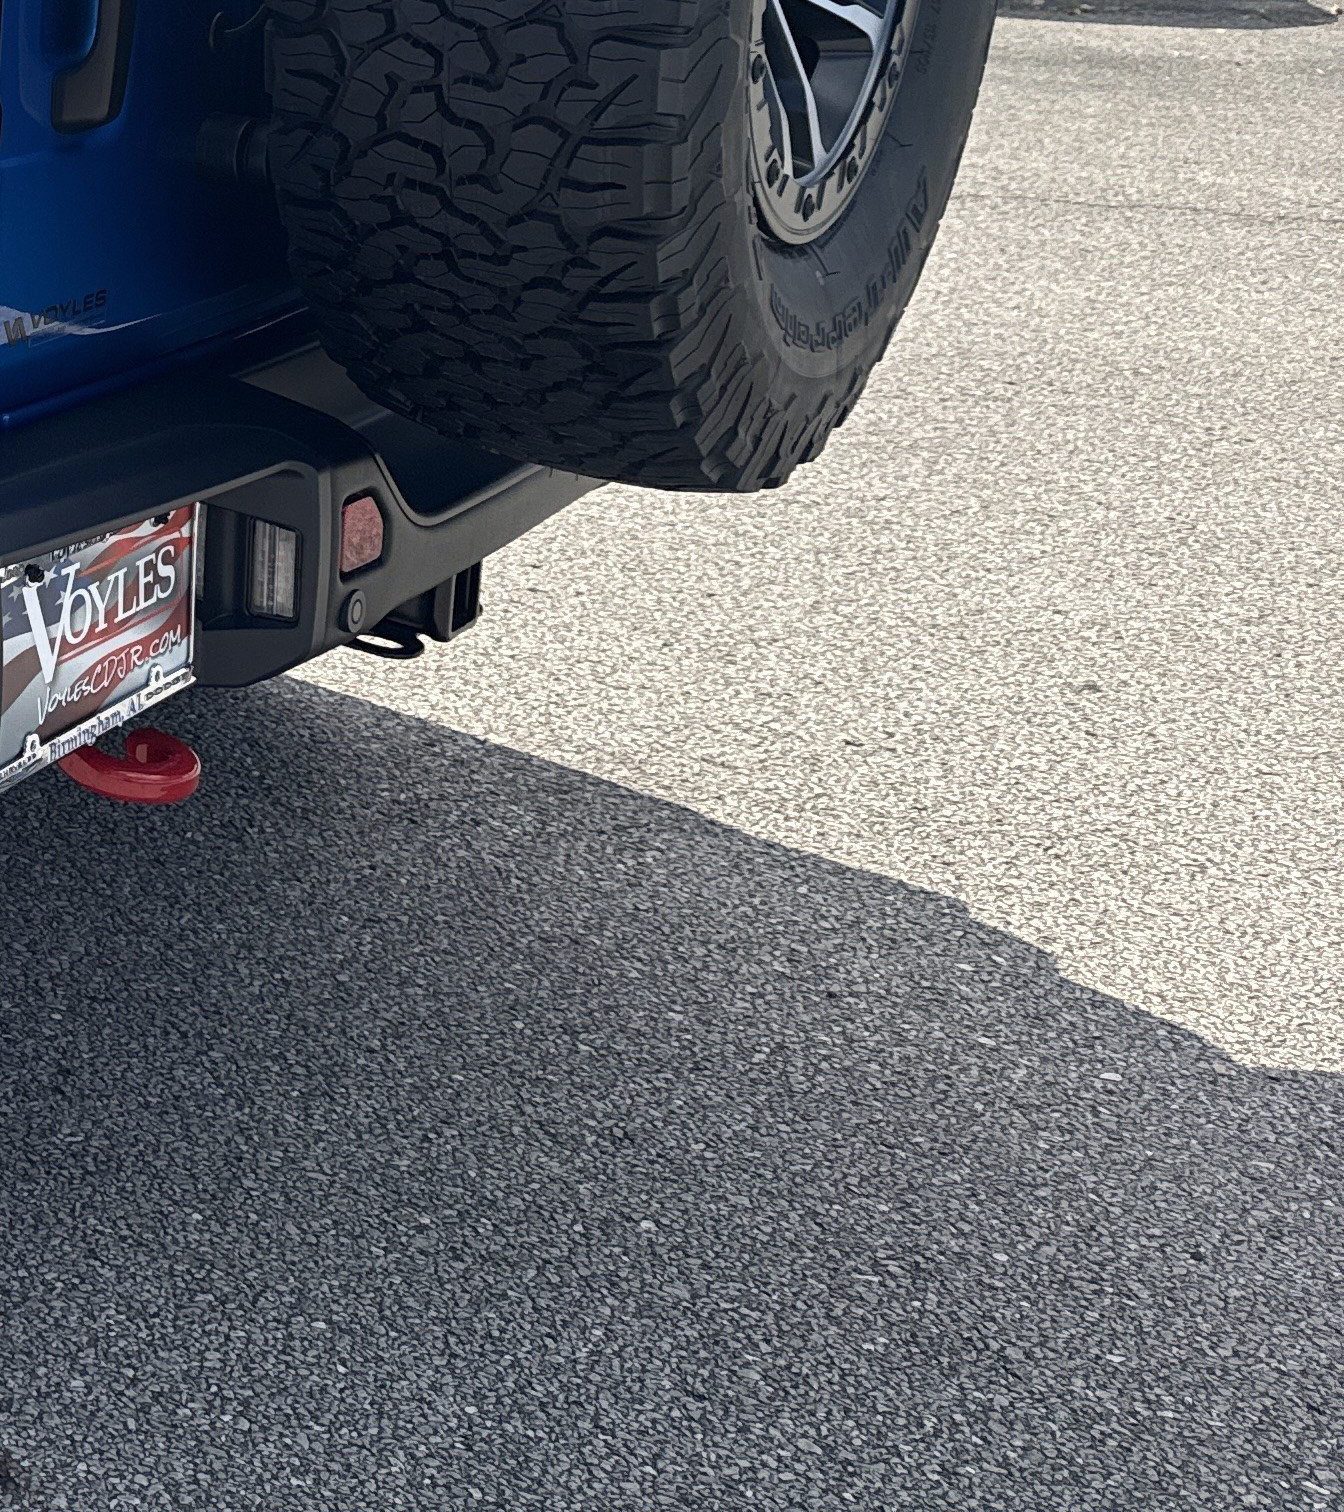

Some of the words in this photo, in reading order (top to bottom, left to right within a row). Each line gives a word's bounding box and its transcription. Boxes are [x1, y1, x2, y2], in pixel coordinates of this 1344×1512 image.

[31, 288, 109, 330] VOYLES
[22, 545, 176, 684] VOYLES
[48, 710, 125, 763] Birmingham,
